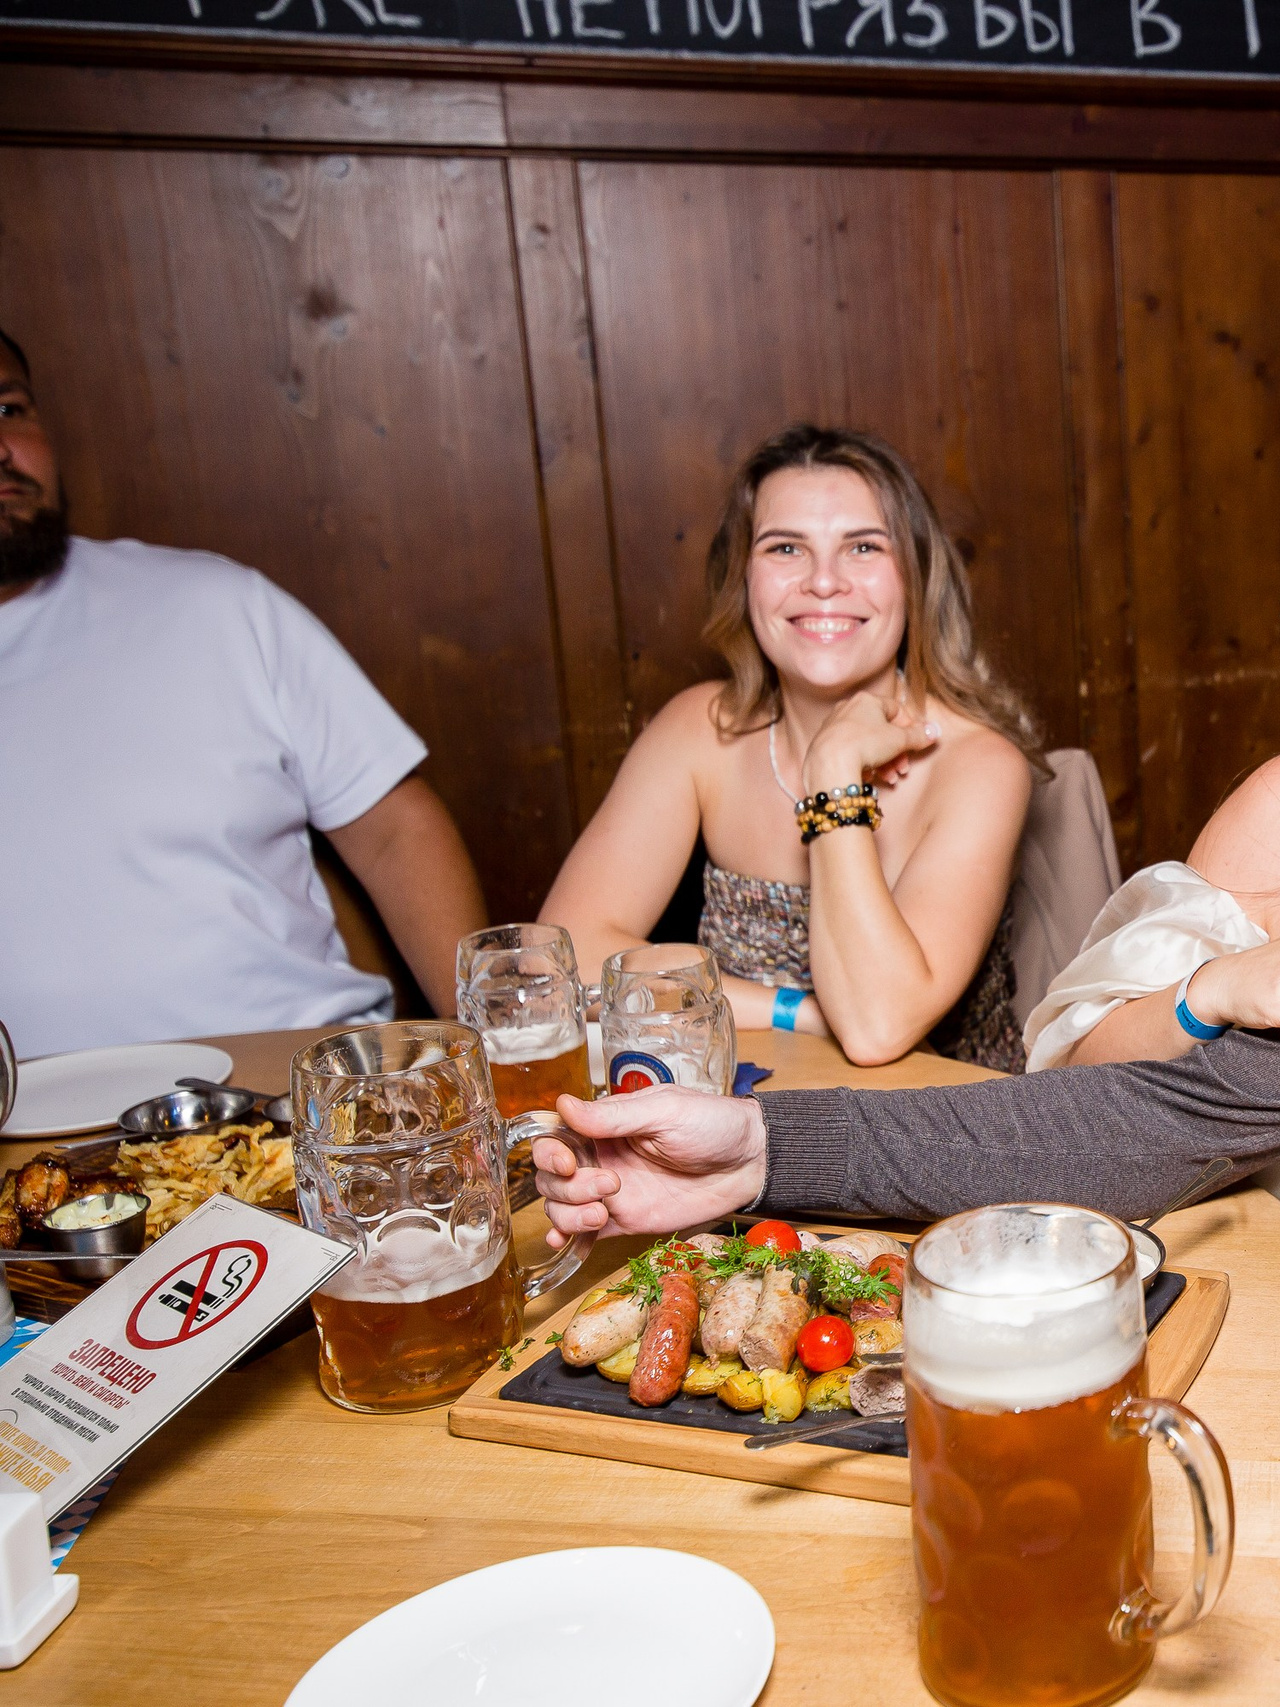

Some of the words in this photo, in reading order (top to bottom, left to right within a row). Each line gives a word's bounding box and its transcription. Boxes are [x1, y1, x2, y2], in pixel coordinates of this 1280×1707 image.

[1130, 0, 1182, 59] В
[50, 1362, 78, 1382] КУРИТЬ
[72, 1374, 95, 1391] ВЕЙП
[87, 1383, 100, 1394] И
[68, 1338, 157, 1395] ЗАПРЕЩЕНО
[11, 1388, 21, 1396] В
[40, 1385, 49, 1393] И
[43, 1387, 67, 1404] ПАРИТЬ
[15, 1390, 50, 1414] СПЕЦИАЛЬНО
[62, 1398, 101, 1422] РАЗРЕШАЕТСЯ
[74, 1425, 101, 1443] МЕСТАХ
[95, 1417, 119, 1433] ТОЛЬКО
[10, 1432, 39, 1454] КУРИТЬ
[30, 1445, 48, 1459] ЗА
[38, 1450, 72, 1474] СТОЛОМ
[9, 1459, 56, 1493] КАЛЬЯН
